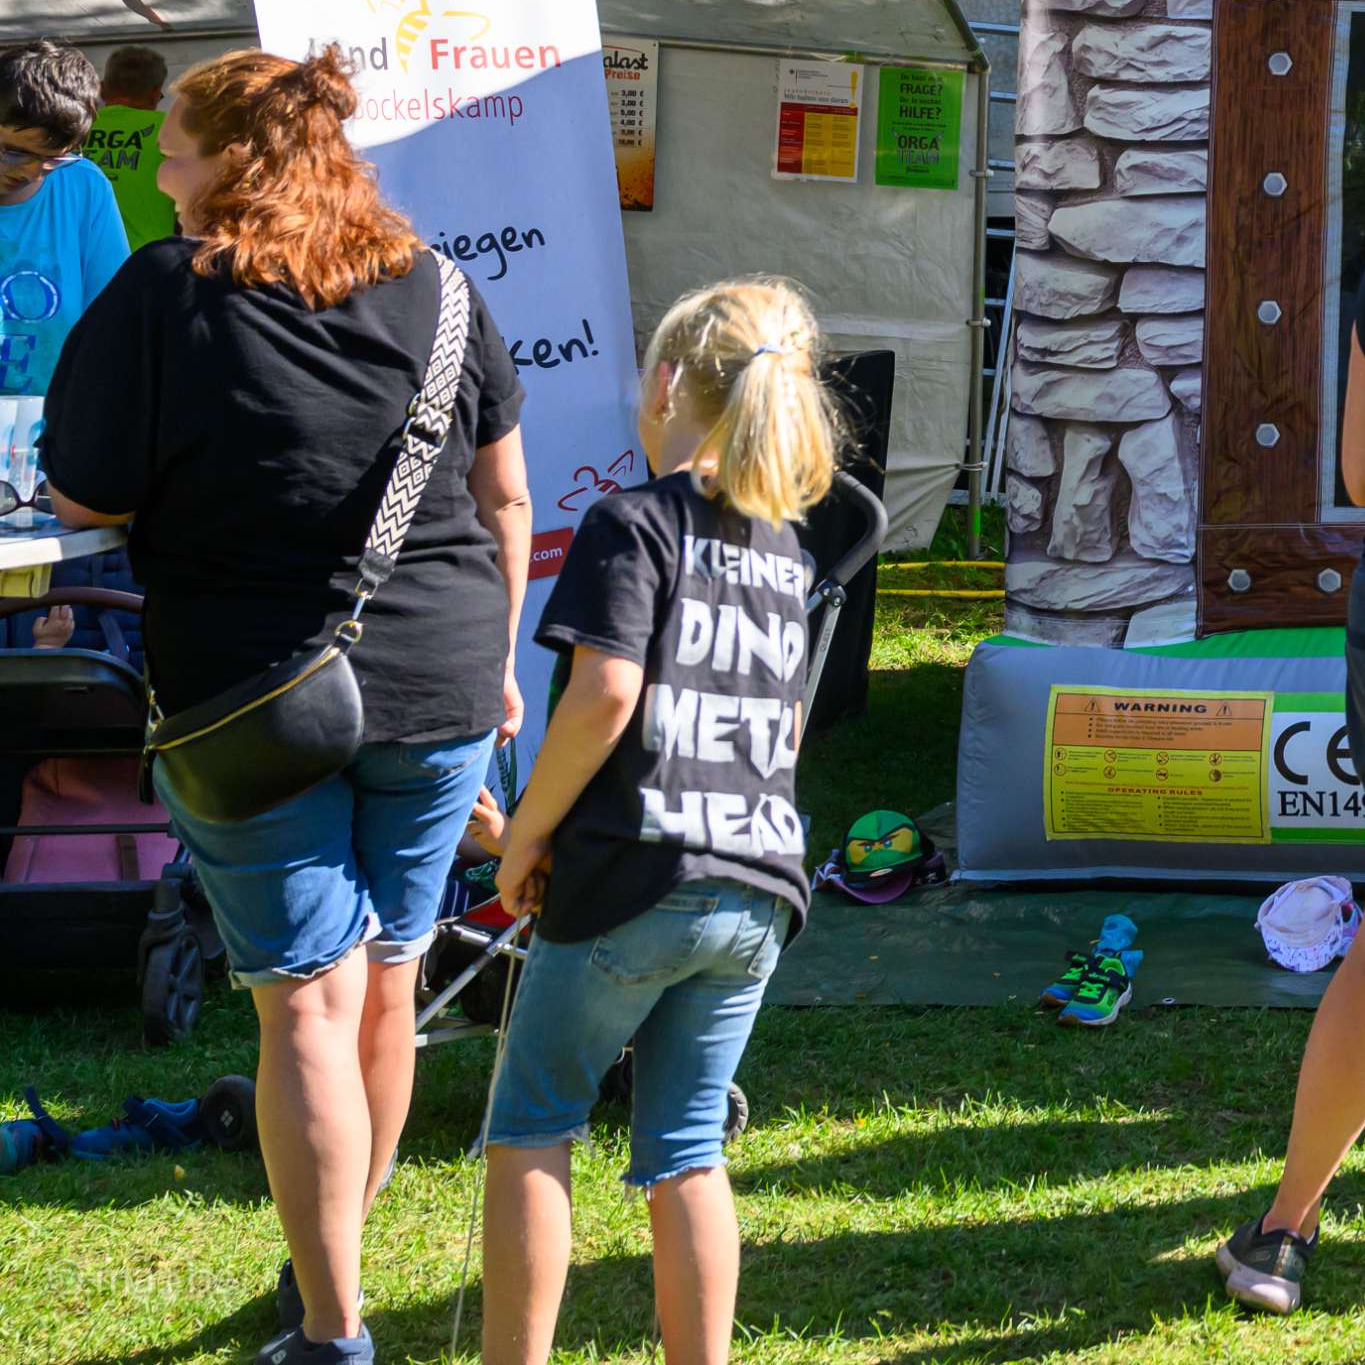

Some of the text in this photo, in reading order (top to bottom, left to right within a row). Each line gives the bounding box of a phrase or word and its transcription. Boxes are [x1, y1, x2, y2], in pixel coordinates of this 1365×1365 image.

[430, 38, 562, 71] Frauen
[603, 50, 649, 70] alast
[900, 83, 943, 96] FRAGE?
[899, 106, 942, 120] HILFE?
[83, 129, 142, 150] RGA
[898, 135, 940, 150] ORGA
[84, 148, 140, 170] EAM
[502, 318, 599, 375] ken!
[530, 547, 563, 563] .com
[676, 598, 804, 683] DINO
[1114, 702, 1208, 714] WARNING
[1107, 787, 1203, 796] OPERATING RULES
[640, 788, 806, 859] HEAD
